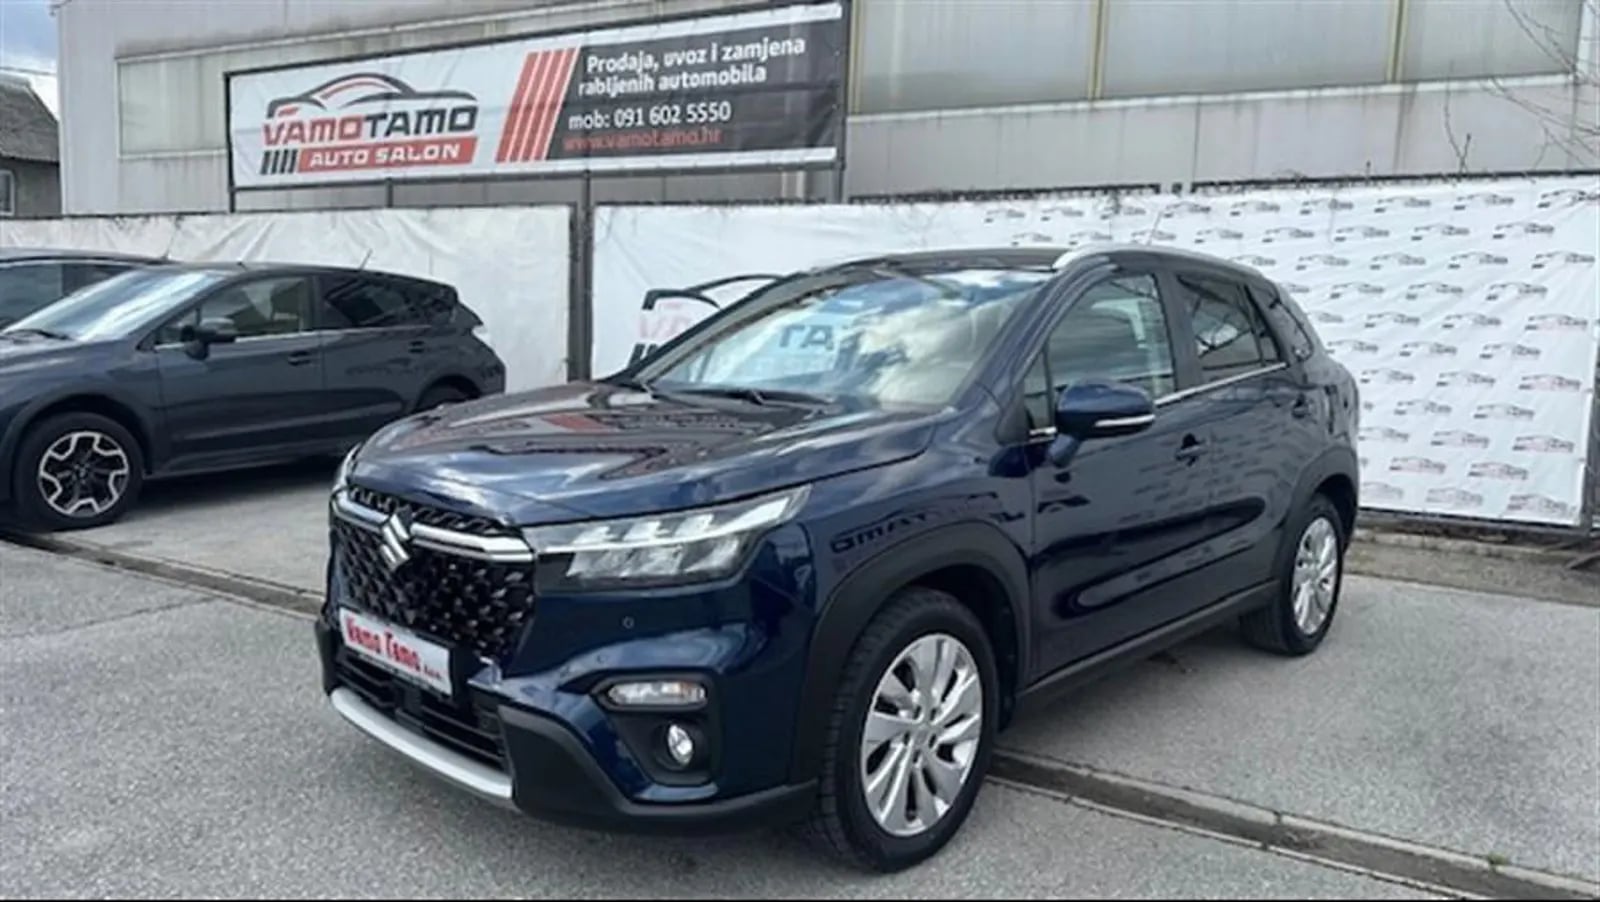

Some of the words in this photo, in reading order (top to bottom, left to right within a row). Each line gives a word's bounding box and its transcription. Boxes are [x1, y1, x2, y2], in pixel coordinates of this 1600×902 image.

[586, 50, 660, 74] Prodaja,
[663, 50, 707, 67] uvoz
[721, 37, 807, 62] zamjena
[578, 74, 655, 98] rabljenih
[658, 64, 768, 91] automobila
[263, 105, 479, 146] VAMOTAMO
[568, 112, 611, 130] mob:
[613, 107, 645, 127] 091
[648, 105, 682, 124] 602
[685, 101, 732, 121] 5550
[309, 151, 370, 169] AUTO
[374, 144, 461, 165] SALON
